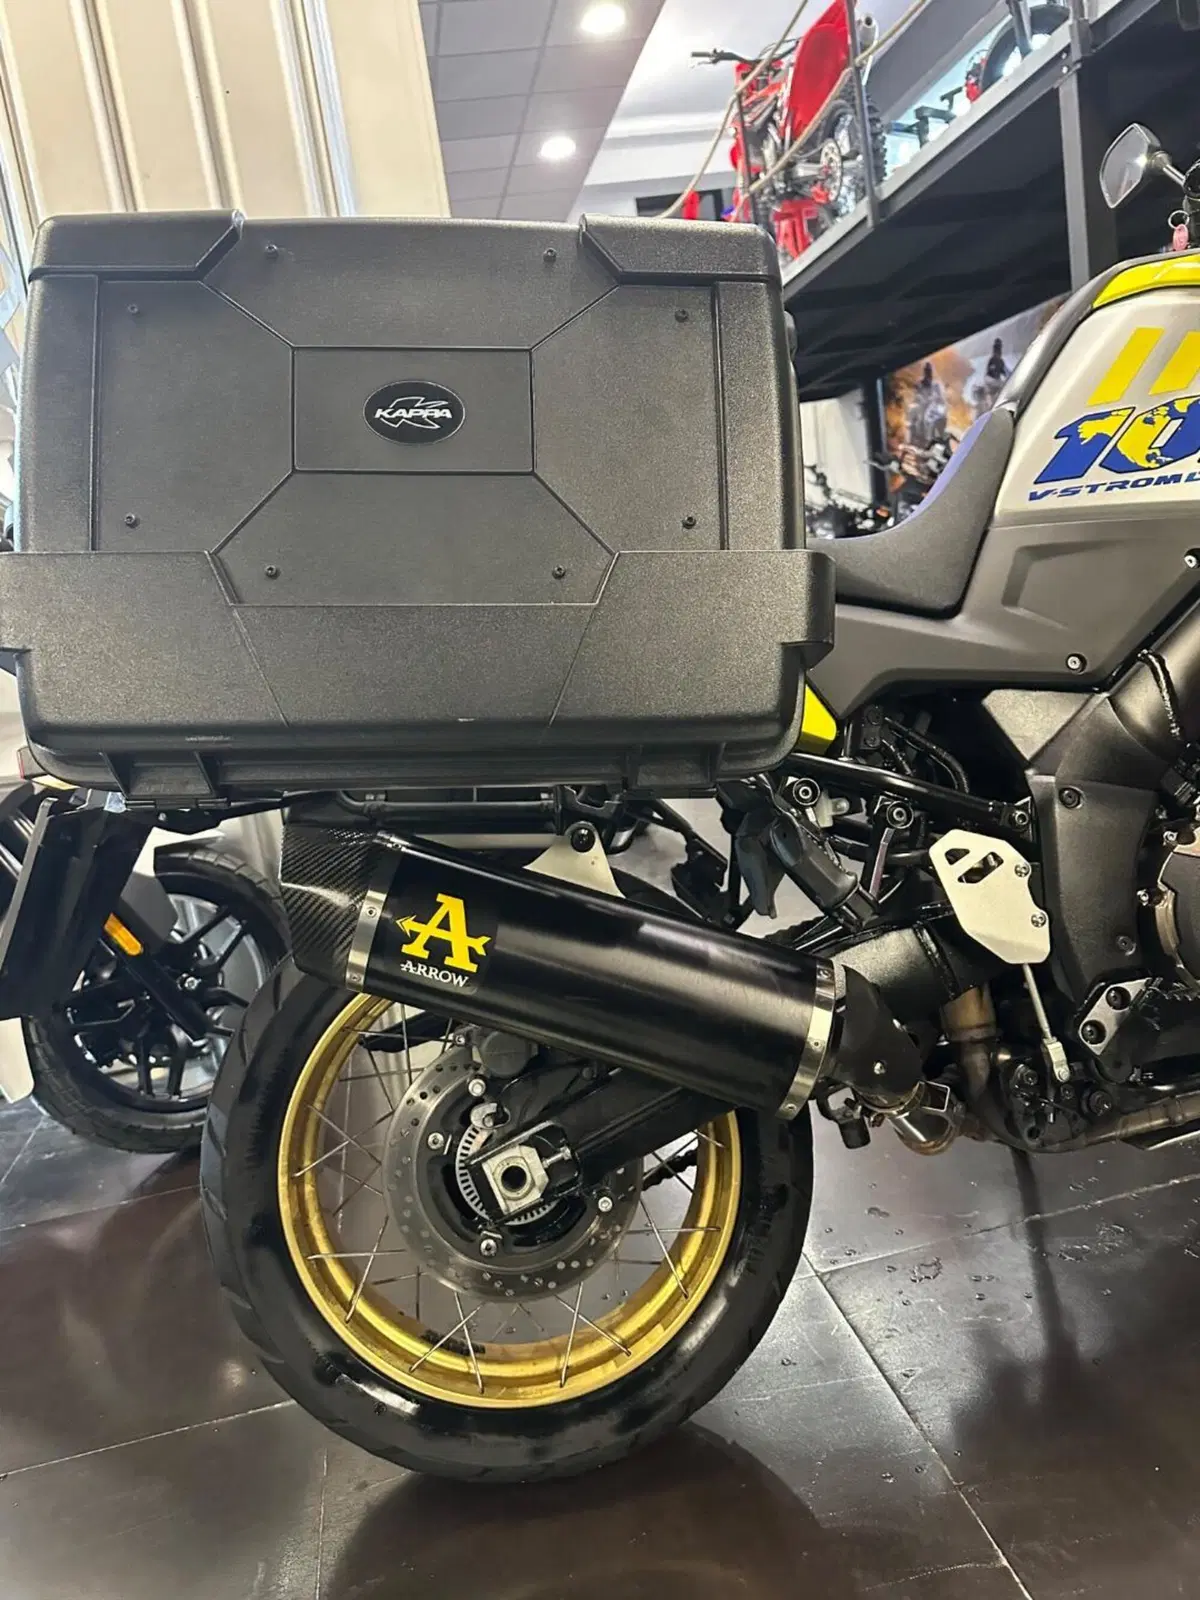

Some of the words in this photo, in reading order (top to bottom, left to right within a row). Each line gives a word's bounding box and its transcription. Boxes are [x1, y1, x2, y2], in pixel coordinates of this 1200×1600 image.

[374, 408, 452, 419] KAPPA
[1033, 395, 1200, 485] 10
[400, 960, 469, 988] ARROW
